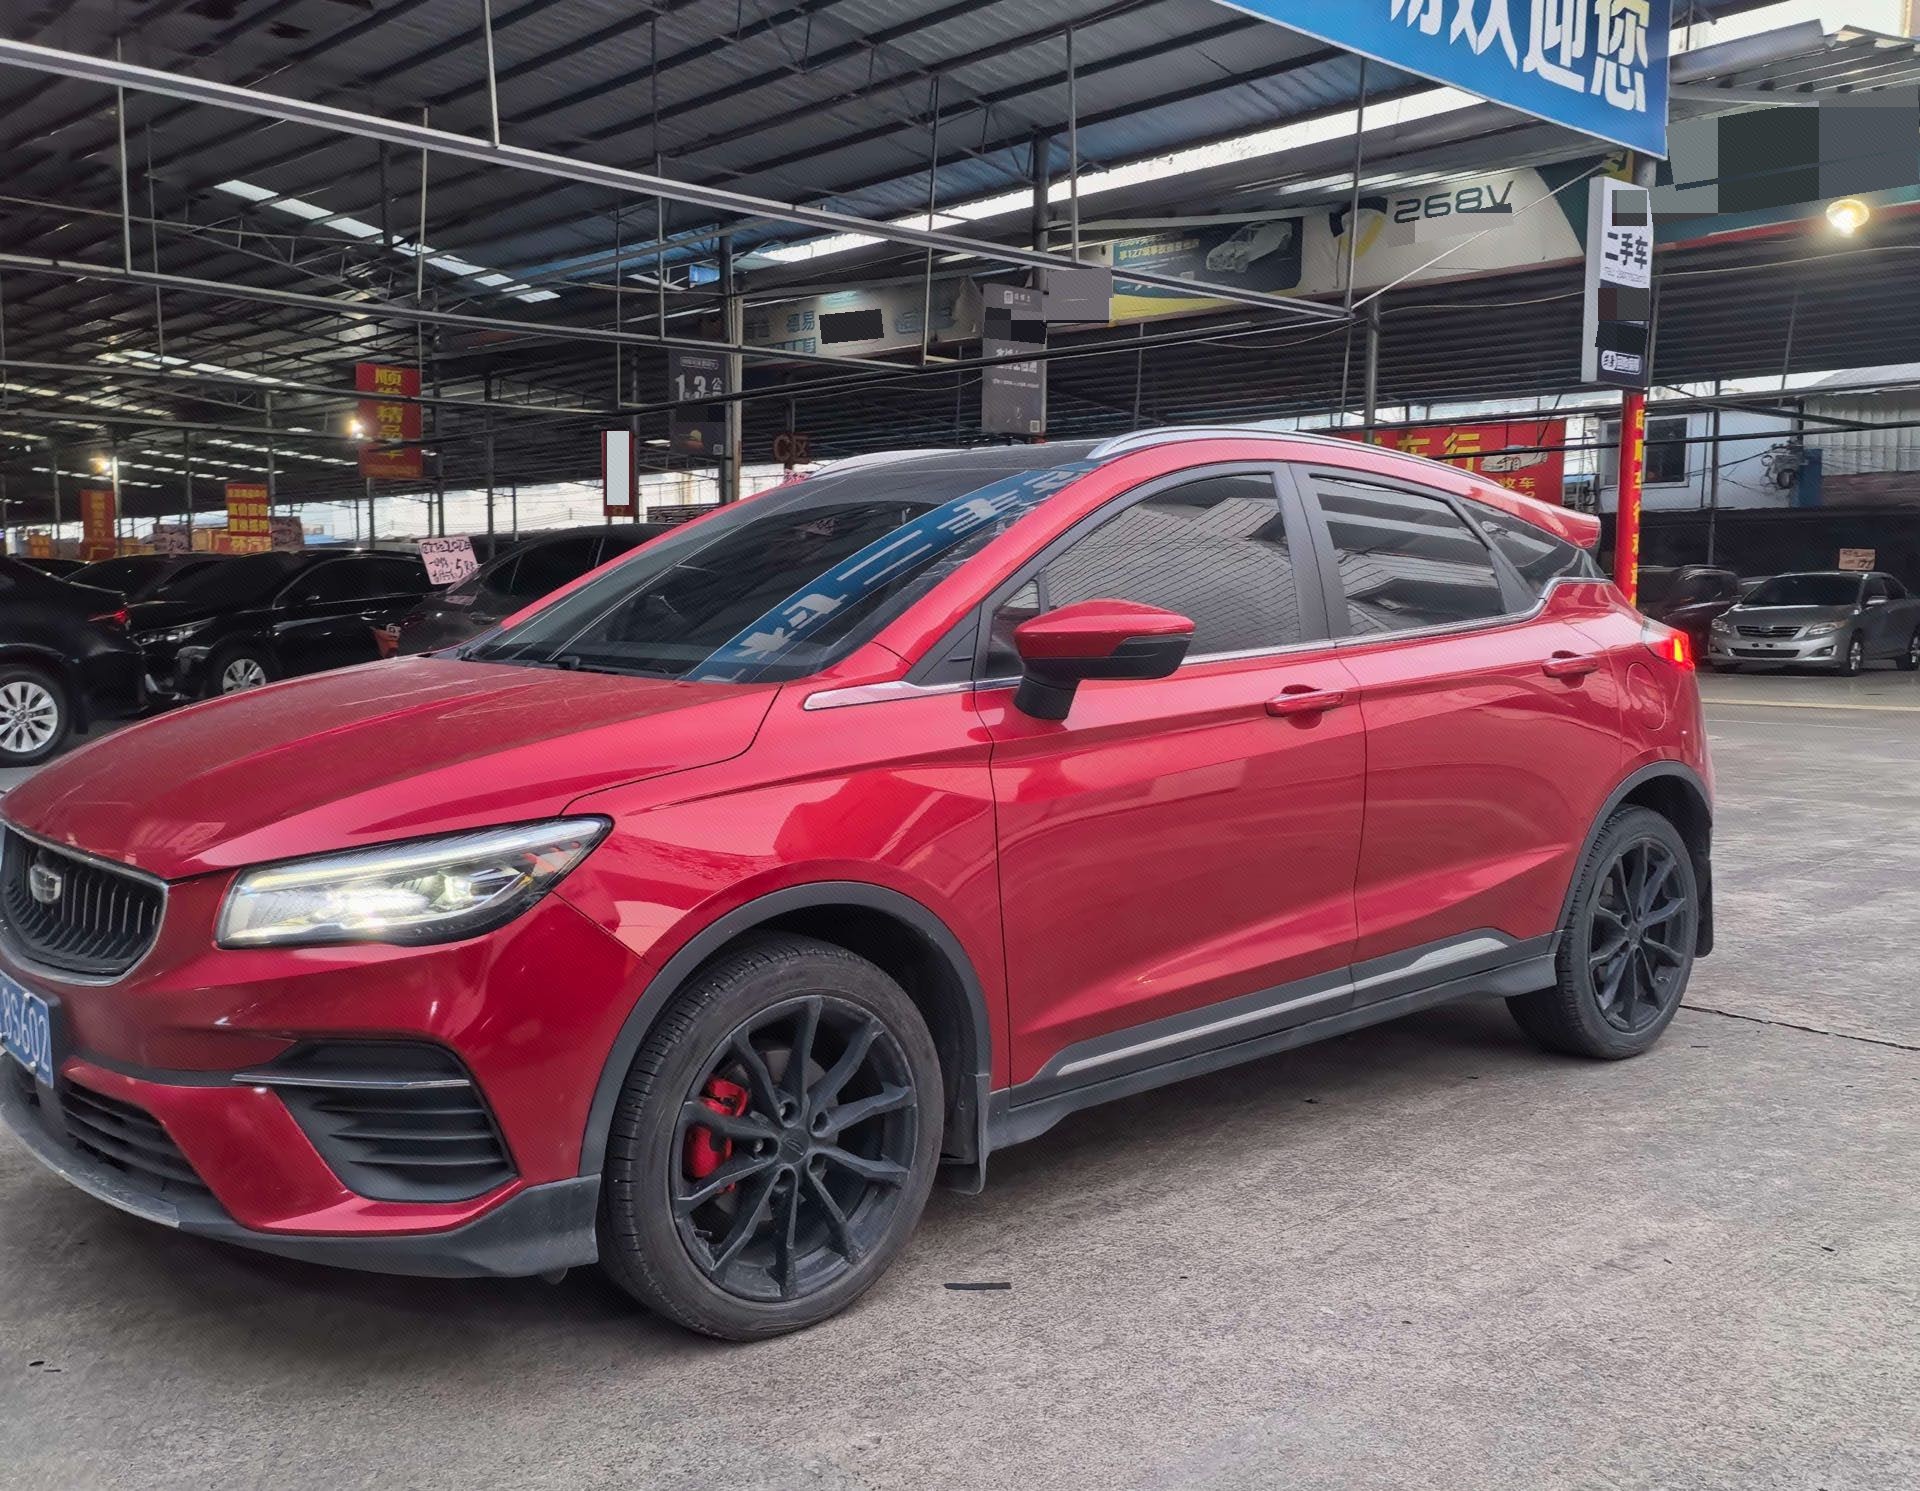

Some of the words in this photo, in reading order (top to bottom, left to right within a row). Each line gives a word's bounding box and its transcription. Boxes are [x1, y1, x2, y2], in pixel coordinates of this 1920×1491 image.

[1391, 0, 1649, 113] 欢迎您
[1393, 180, 1514, 224] 268V
[1604, 231, 1649, 270] 二手车
